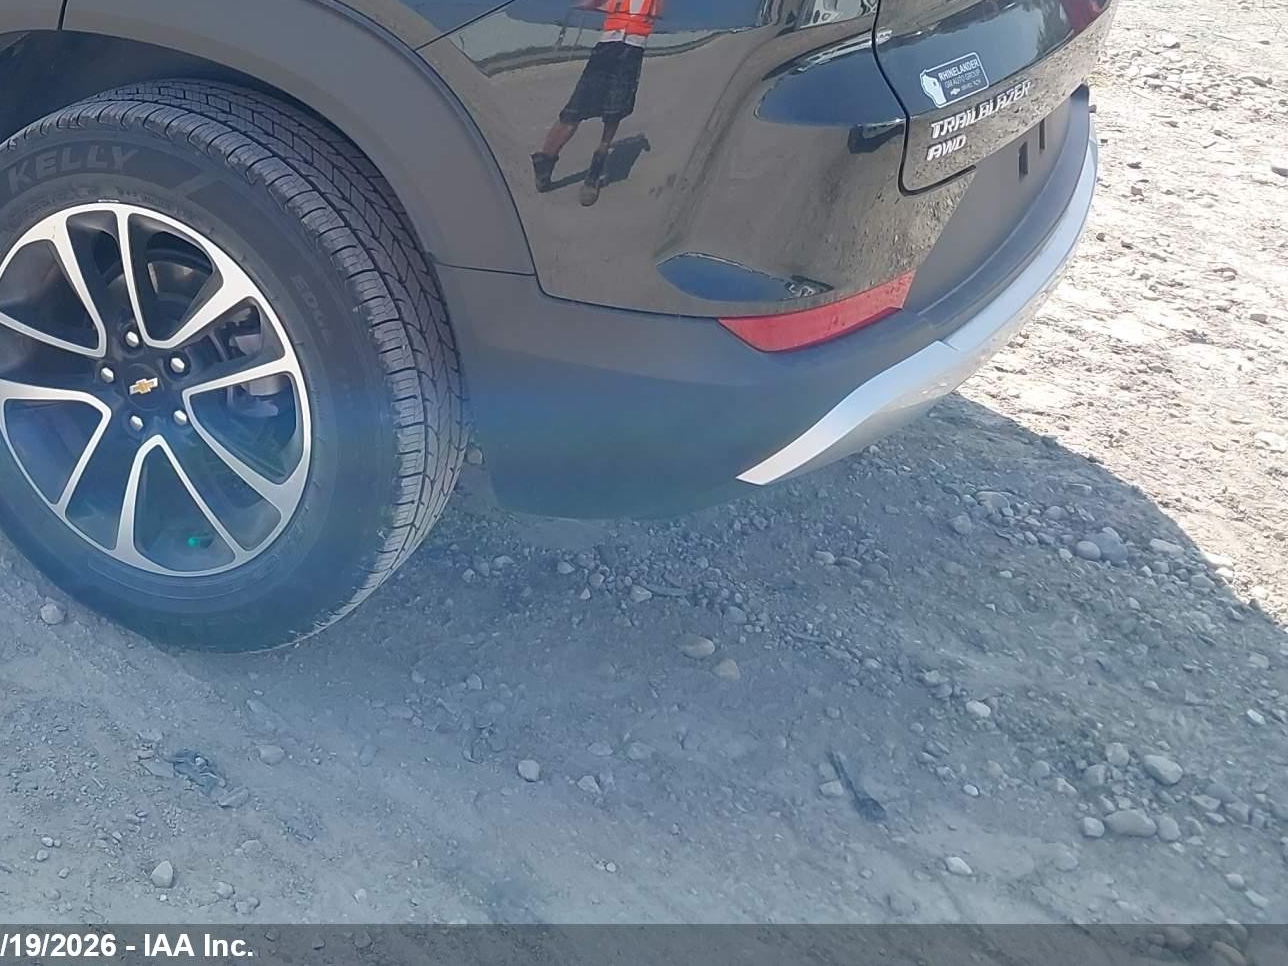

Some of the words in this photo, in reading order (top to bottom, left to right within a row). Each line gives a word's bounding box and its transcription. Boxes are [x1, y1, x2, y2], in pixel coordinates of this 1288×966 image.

[938, 58, 980, 81] RHINELANDER
[931, 79, 1031, 139] TRAILBLAZER
[926, 134, 967, 161] AWD
[8, 145, 138, 193] KELLY
